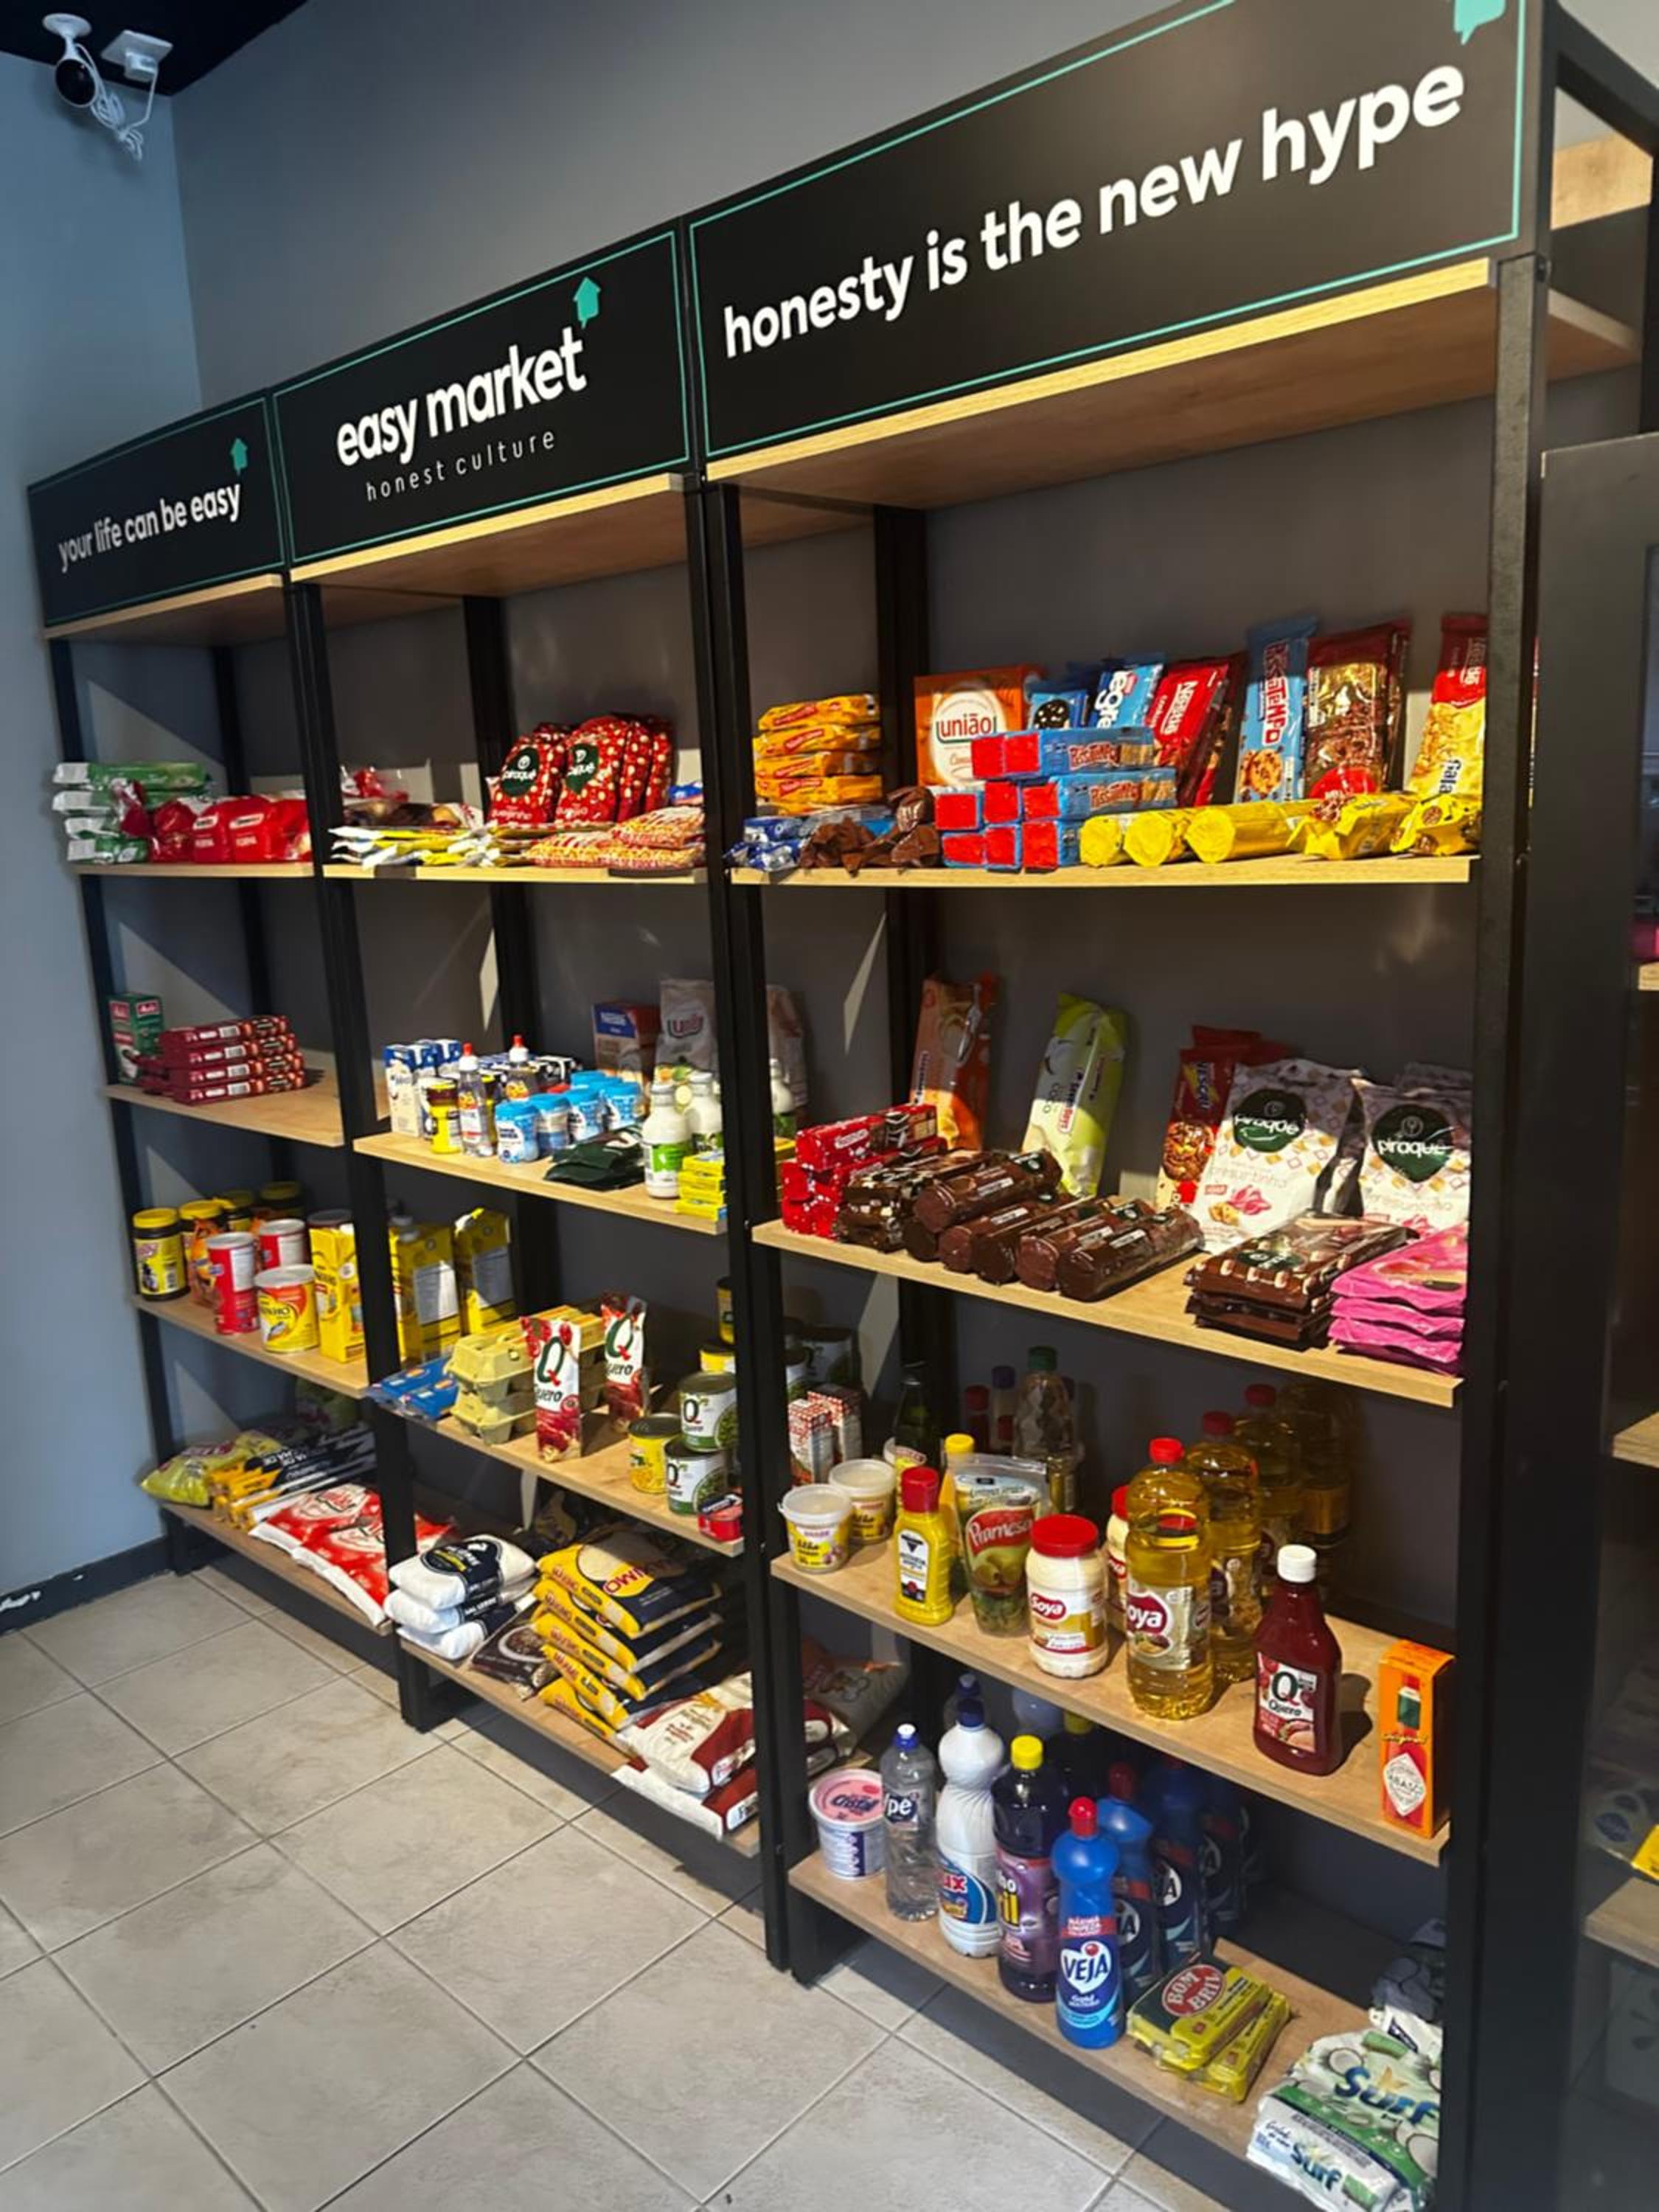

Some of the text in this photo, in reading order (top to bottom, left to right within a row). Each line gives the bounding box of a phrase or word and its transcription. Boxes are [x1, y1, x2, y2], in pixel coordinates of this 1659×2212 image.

[724, 65, 1466, 358] honesty is the new hype
[336, 326, 588, 466] easy market
[366, 431, 555, 502] honest culture
[59, 483, 242, 573] your life can be easy
[940, 712, 992, 738] união
[1030, 1593, 1063, 1617] Soya
[1127, 1602, 1164, 1630] oya
[1268, 1698, 1302, 1717] Quero
[1063, 1952, 1109, 1984] VEJA
[1166, 1971, 1201, 2005] BOM
[1290, 2141, 1343, 2192] Surf
